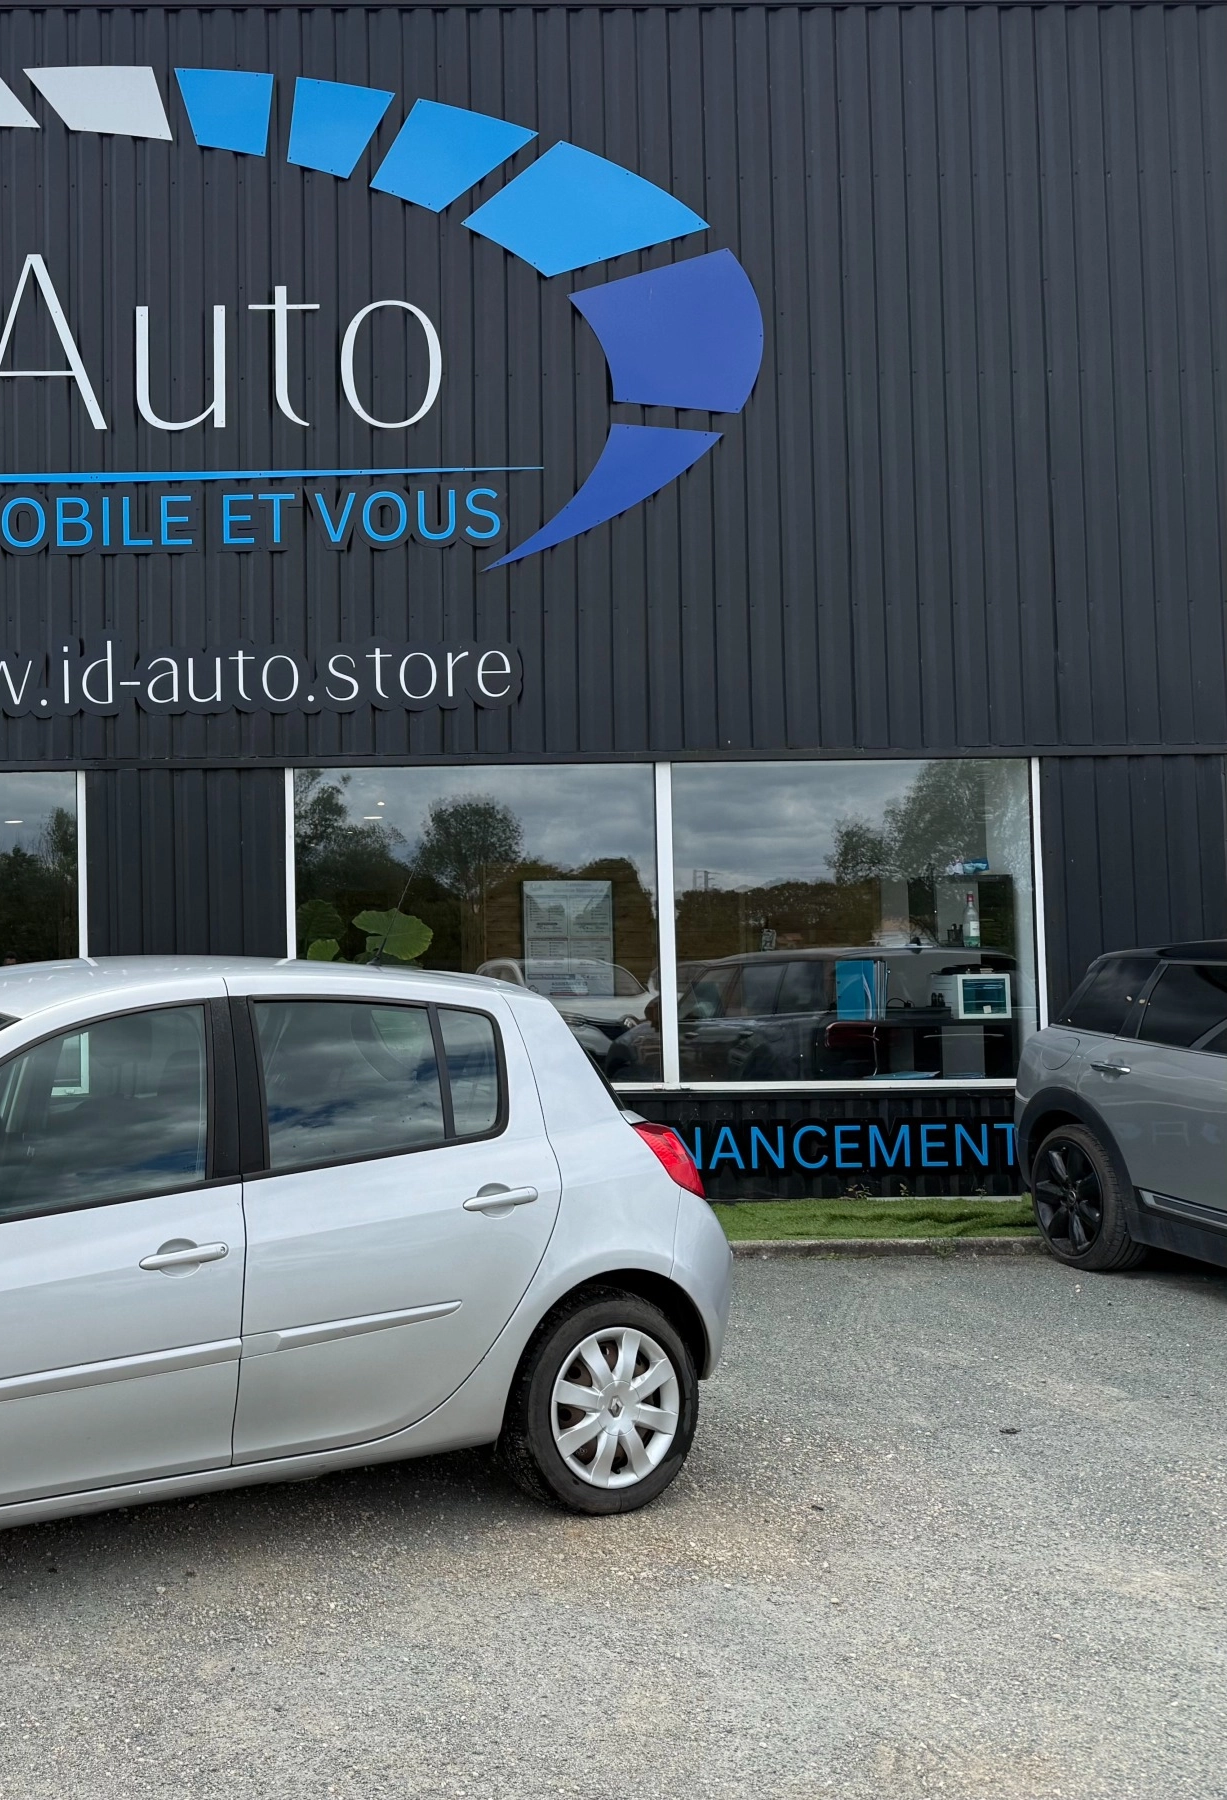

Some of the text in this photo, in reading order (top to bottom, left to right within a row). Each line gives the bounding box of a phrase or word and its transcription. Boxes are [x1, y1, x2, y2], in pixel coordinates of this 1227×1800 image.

[222, 493, 295, 545] ET
[316, 487, 502, 543] VOUS
[672, 1123, 1015, 1170] NANCEMENT
